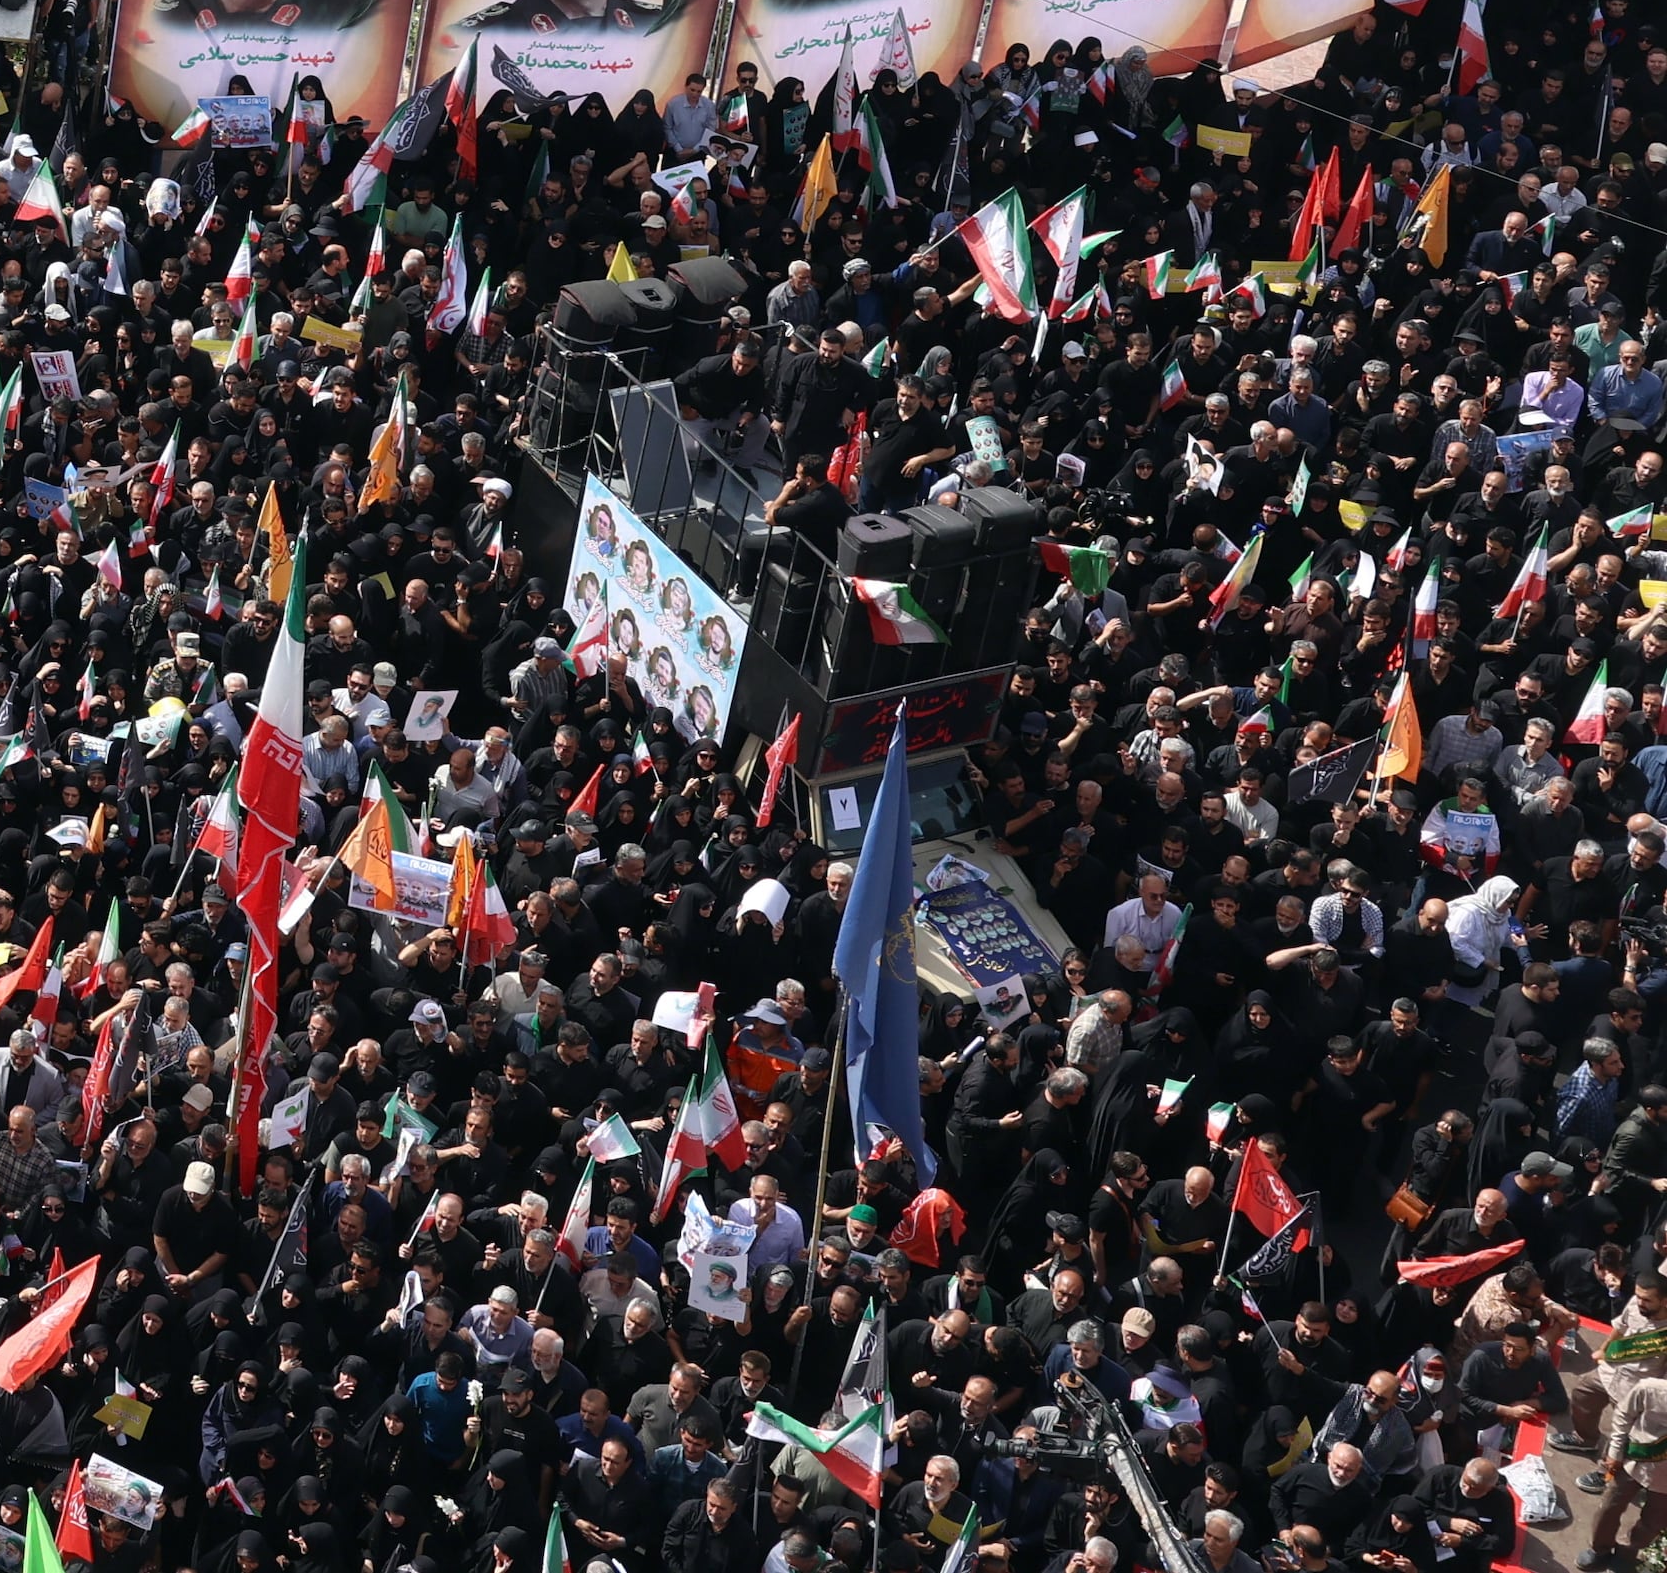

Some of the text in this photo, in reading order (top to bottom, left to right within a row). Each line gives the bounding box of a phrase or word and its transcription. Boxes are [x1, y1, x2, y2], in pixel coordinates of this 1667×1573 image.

[179, 47, 335, 69] شهید حسین سلامی
[589, 57, 633, 72] شهید
